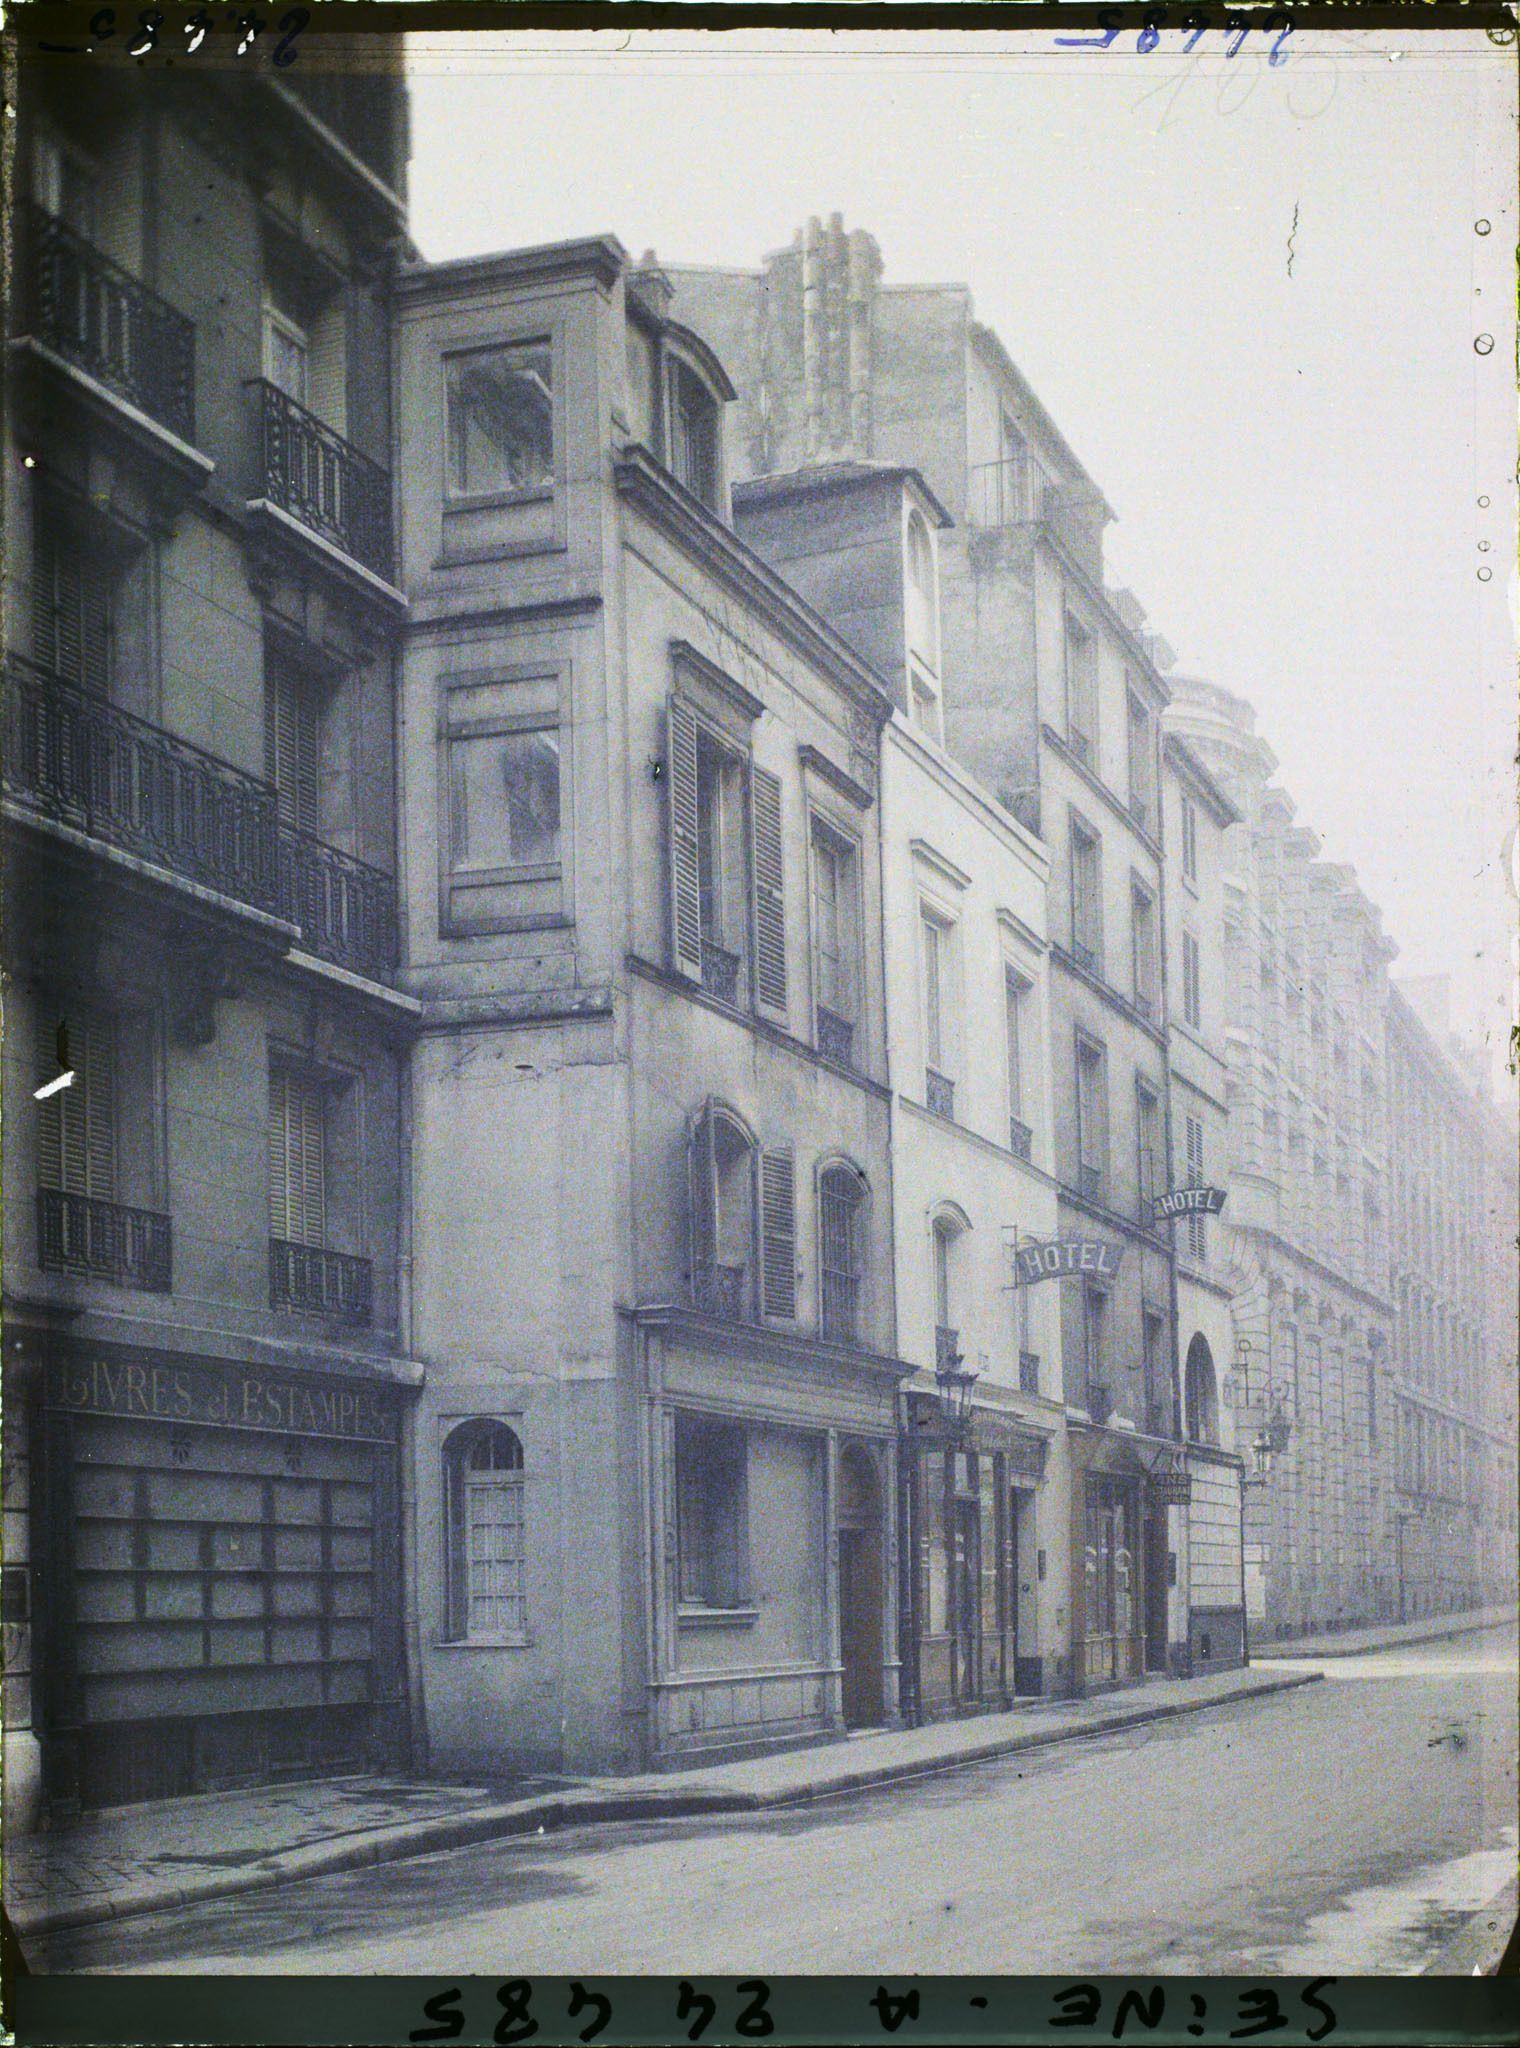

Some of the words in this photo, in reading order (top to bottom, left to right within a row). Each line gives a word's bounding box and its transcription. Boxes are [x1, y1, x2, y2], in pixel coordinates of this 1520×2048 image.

[1161, 1189, 1217, 1215] HOTEL
[1023, 1243, 1112, 1277] HOTEL
[63, 1360, 191, 1416] LIVRES
[241, 1379, 390, 1435] ESTAMPES
